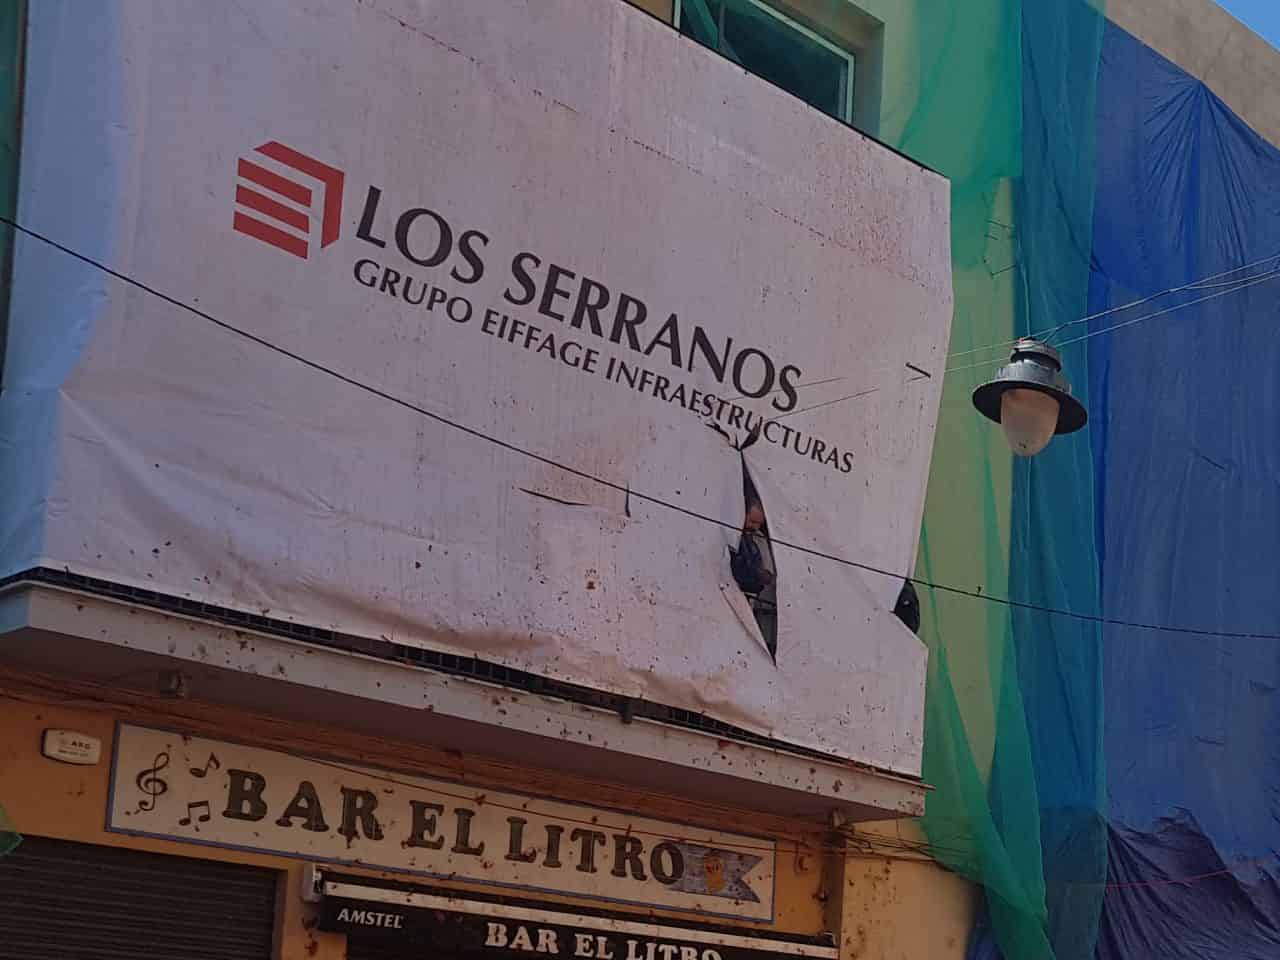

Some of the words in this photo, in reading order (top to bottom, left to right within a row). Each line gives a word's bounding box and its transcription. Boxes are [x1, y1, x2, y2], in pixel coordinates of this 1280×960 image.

[355, 185, 489, 284] LOS
[503, 252, 802, 412] SERRANOS
[353, 258, 473, 323] GRUPO
[481, 310, 600, 373] EIFFAGE
[605, 357, 854, 474] INFRAESTRUCTURAS
[223, 768, 384, 841] BAR
[407, 800, 485, 856] EL
[504, 815, 686, 885] LITRO
[337, 908, 404, 929] AMSTEL
[484, 922, 560, 954] BAR
[574, 933, 613, 960] EL
